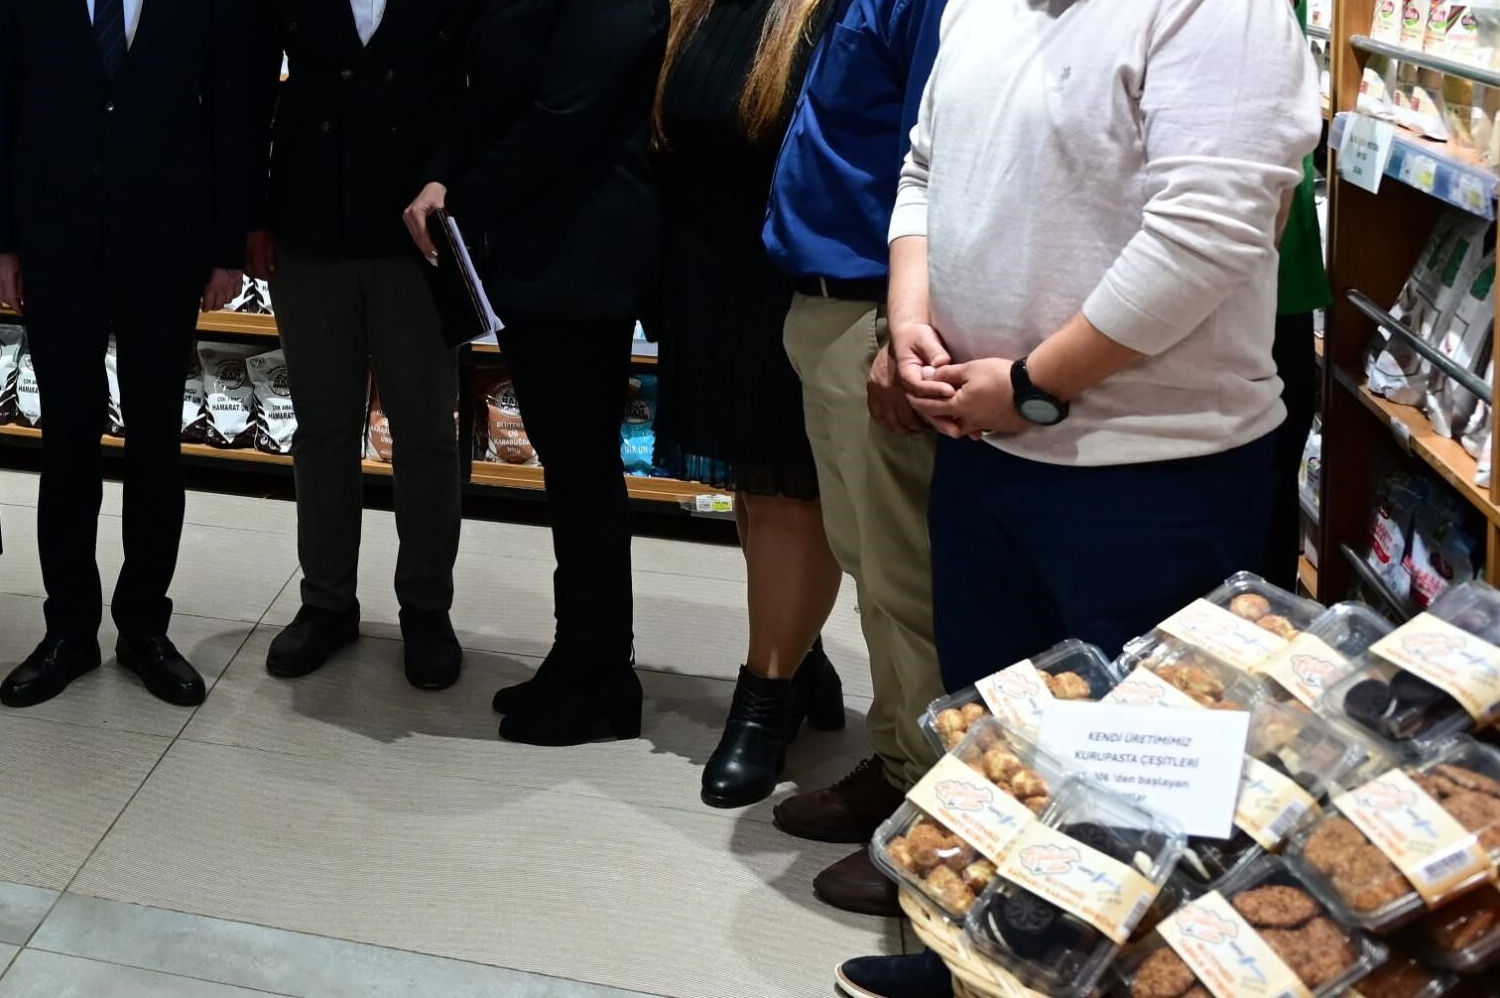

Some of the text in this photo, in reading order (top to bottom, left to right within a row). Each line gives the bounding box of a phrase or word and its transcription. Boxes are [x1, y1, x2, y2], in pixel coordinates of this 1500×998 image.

[493, 437, 530, 446] KARABUĞDA
[1088, 731, 1192, 747] KENDİ ÜRETİMİMİZ
[1075, 751, 1200, 768] KURUPASTA ÇEŞİTLERİ
[1138, 775, 1189, 789] başlayan
